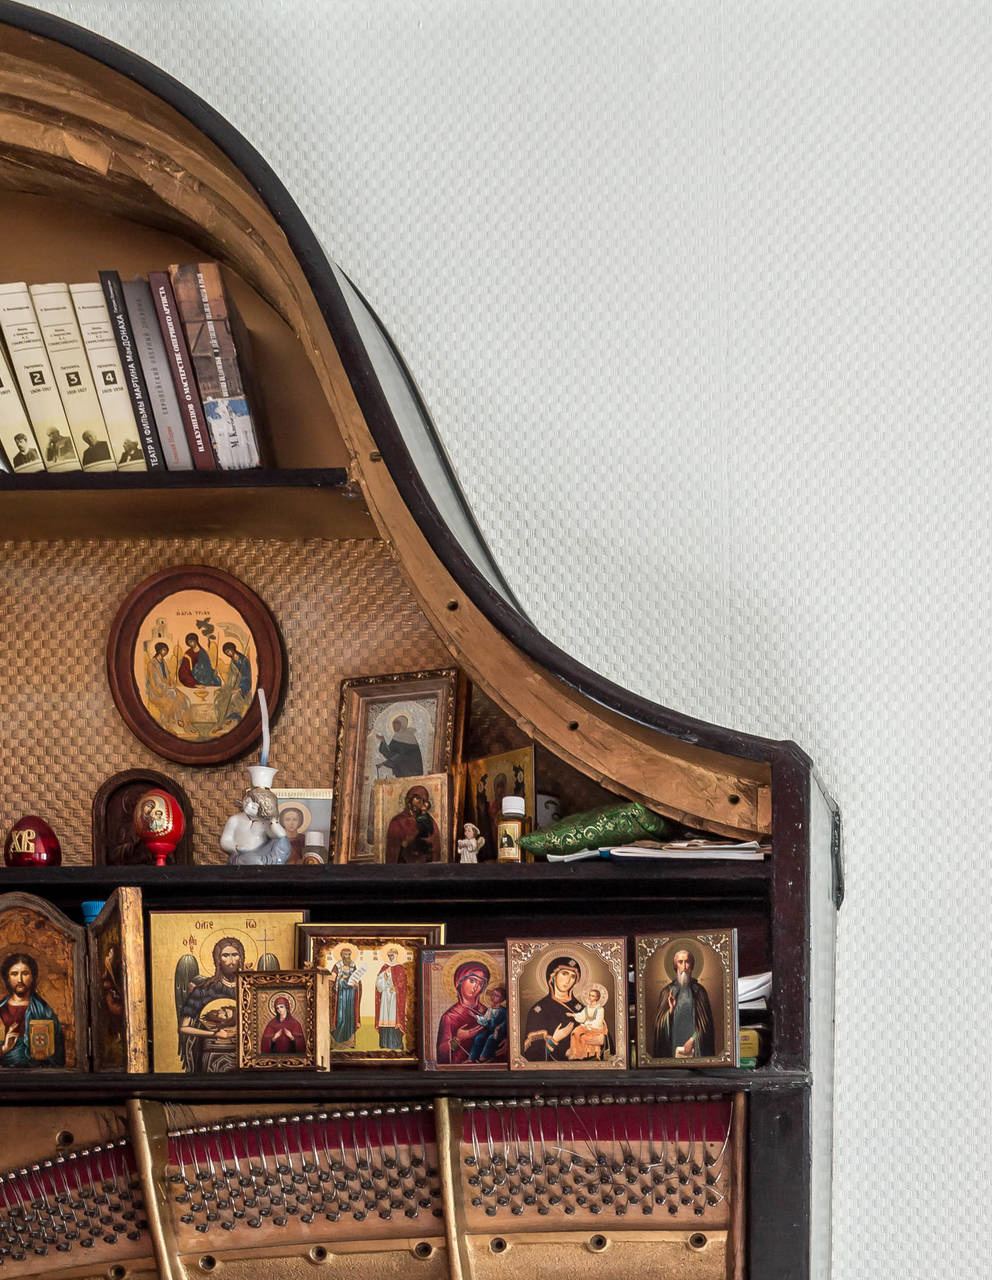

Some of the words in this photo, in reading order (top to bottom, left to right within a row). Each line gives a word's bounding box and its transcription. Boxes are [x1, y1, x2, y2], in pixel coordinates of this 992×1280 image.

[158, 286, 171, 316] АРТИСТА
[32, 373, 42, 383] 2
[69, 374, 79, 384] 3
[105, 372, 114, 382] 4
[129, 363, 142, 399] МАРТИНА
[175, 351, 190, 394] МАСТЕРСТВЕ
[138, 400, 151, 435] ФИЛЬМЫ
[148, 444, 158, 466] ТЕАТР
